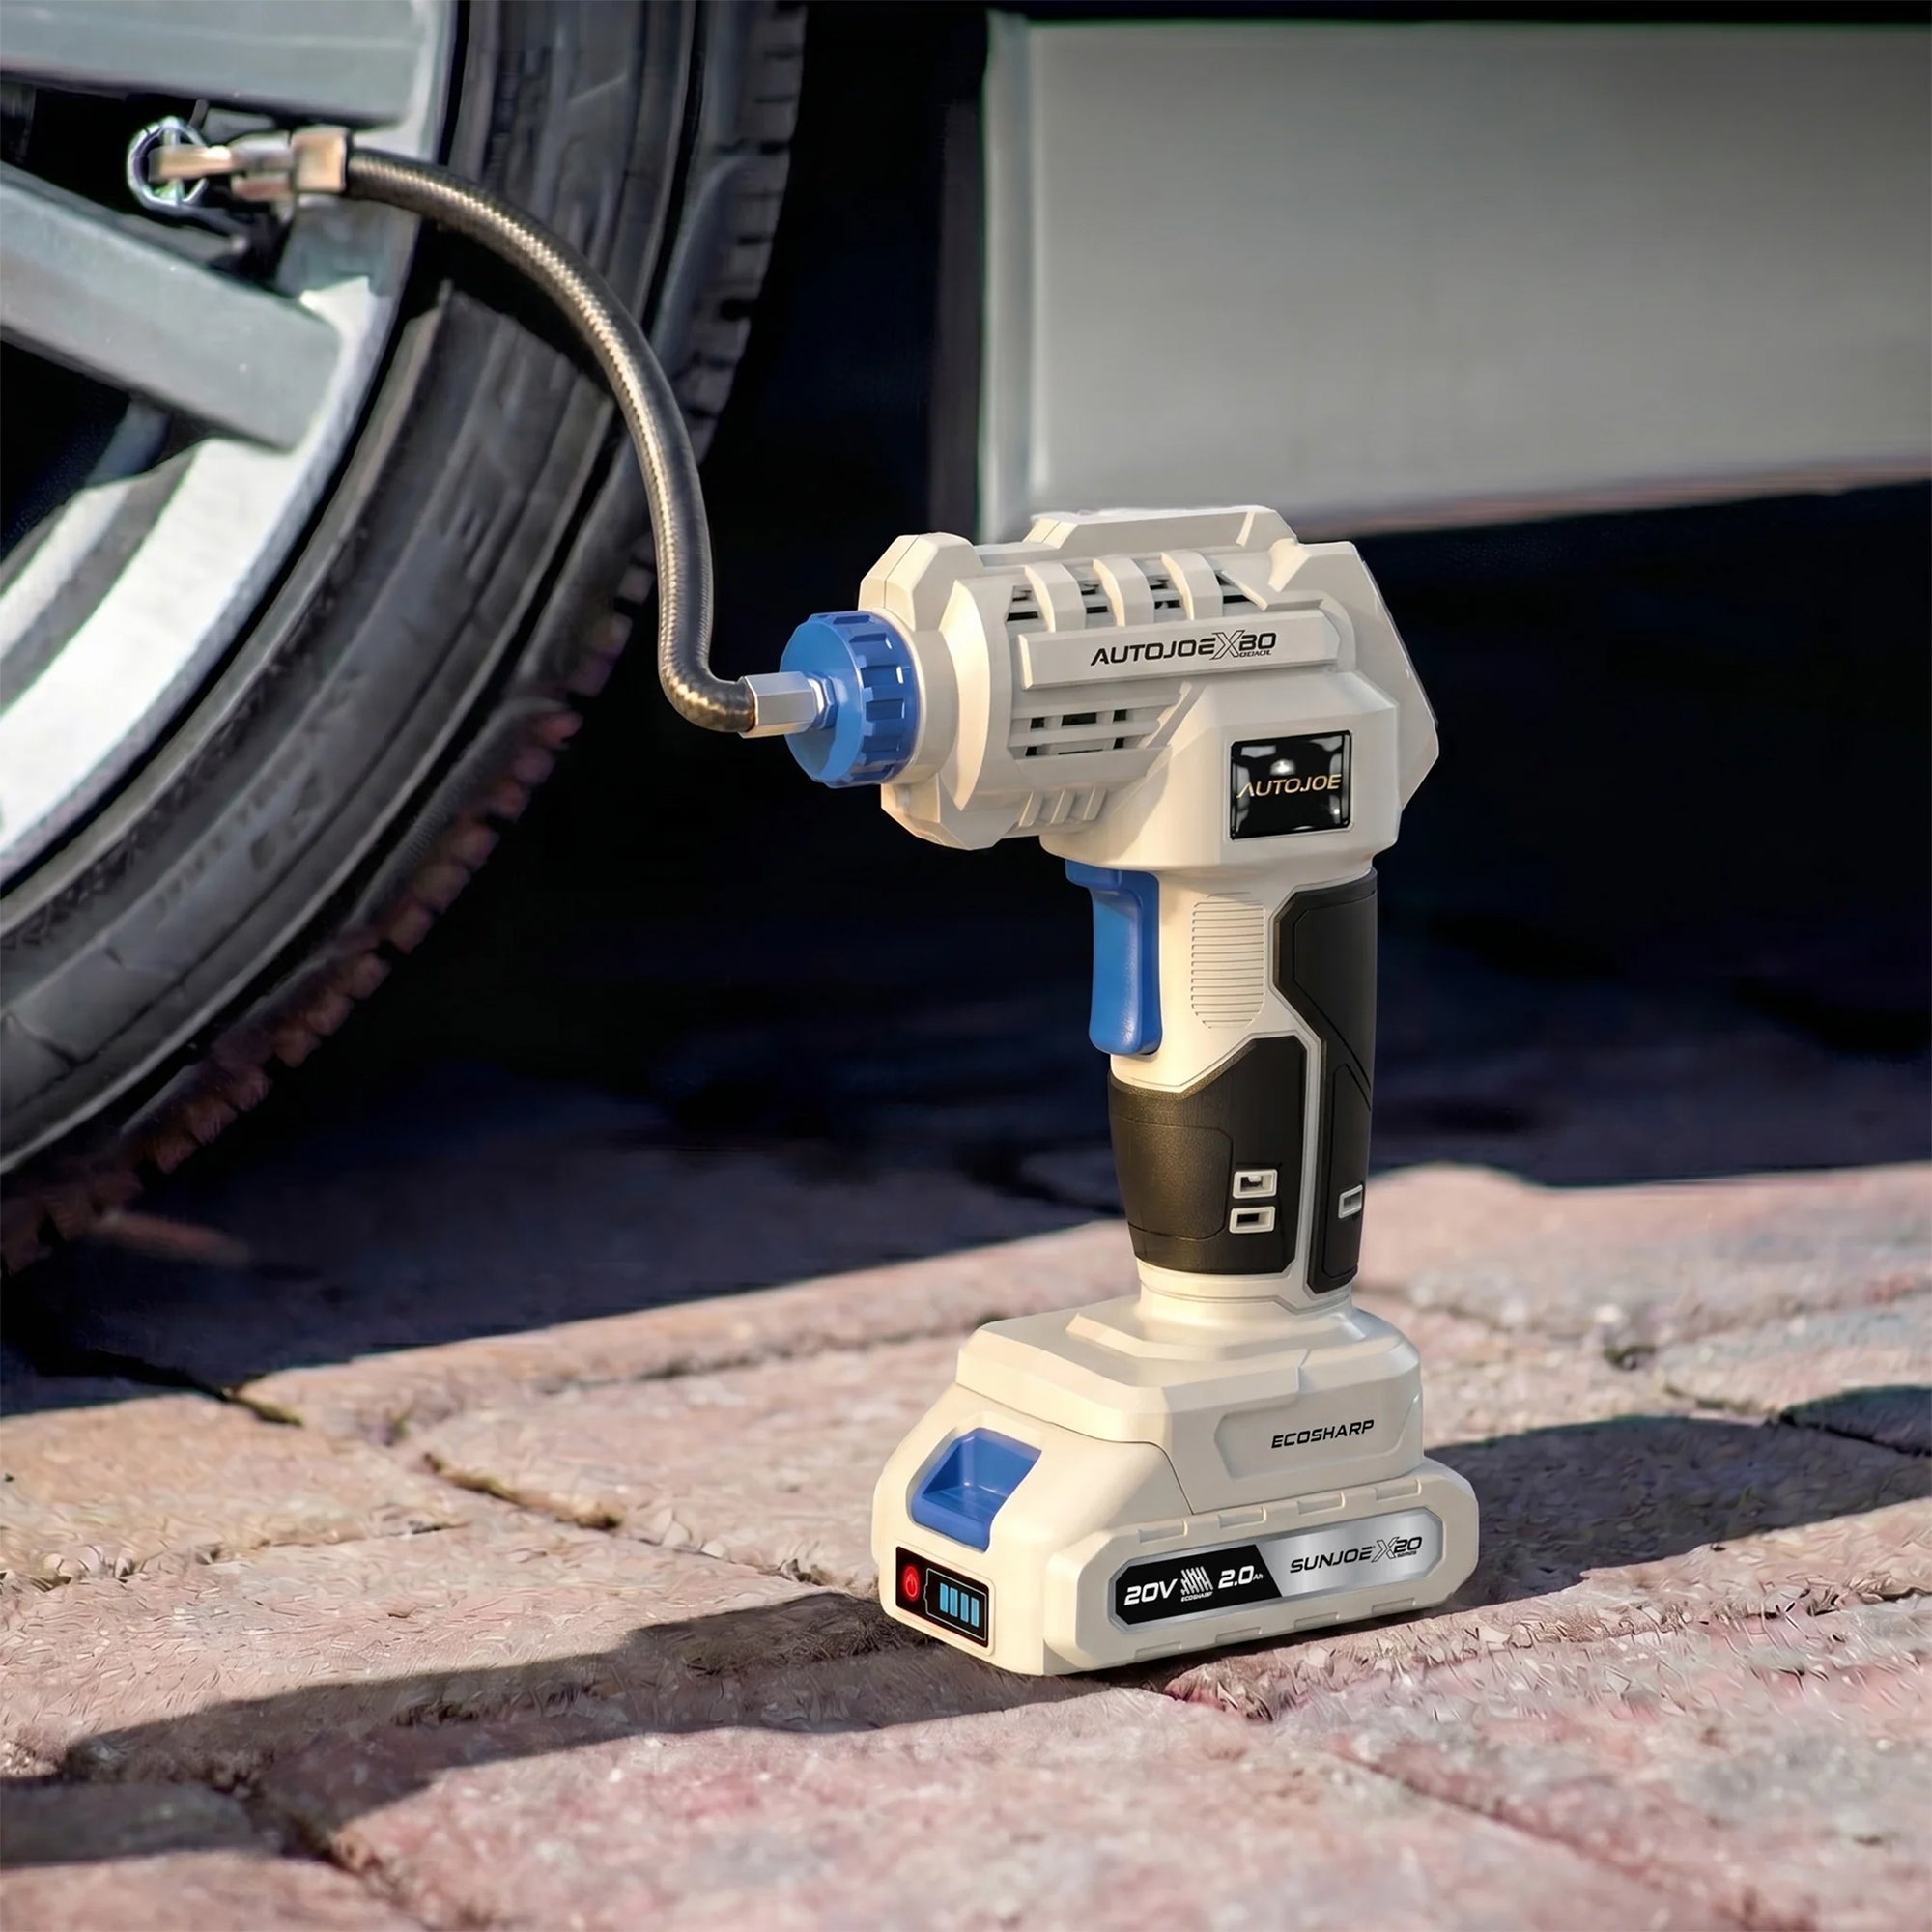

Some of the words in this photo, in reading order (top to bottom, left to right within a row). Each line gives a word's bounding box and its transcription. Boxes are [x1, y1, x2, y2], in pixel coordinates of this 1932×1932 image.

[1236, 774, 1342, 799] AUTOJOE
[1271, 1419, 1374, 1449] ECOSHARP
[1124, 1578, 1178, 1605] 20V
